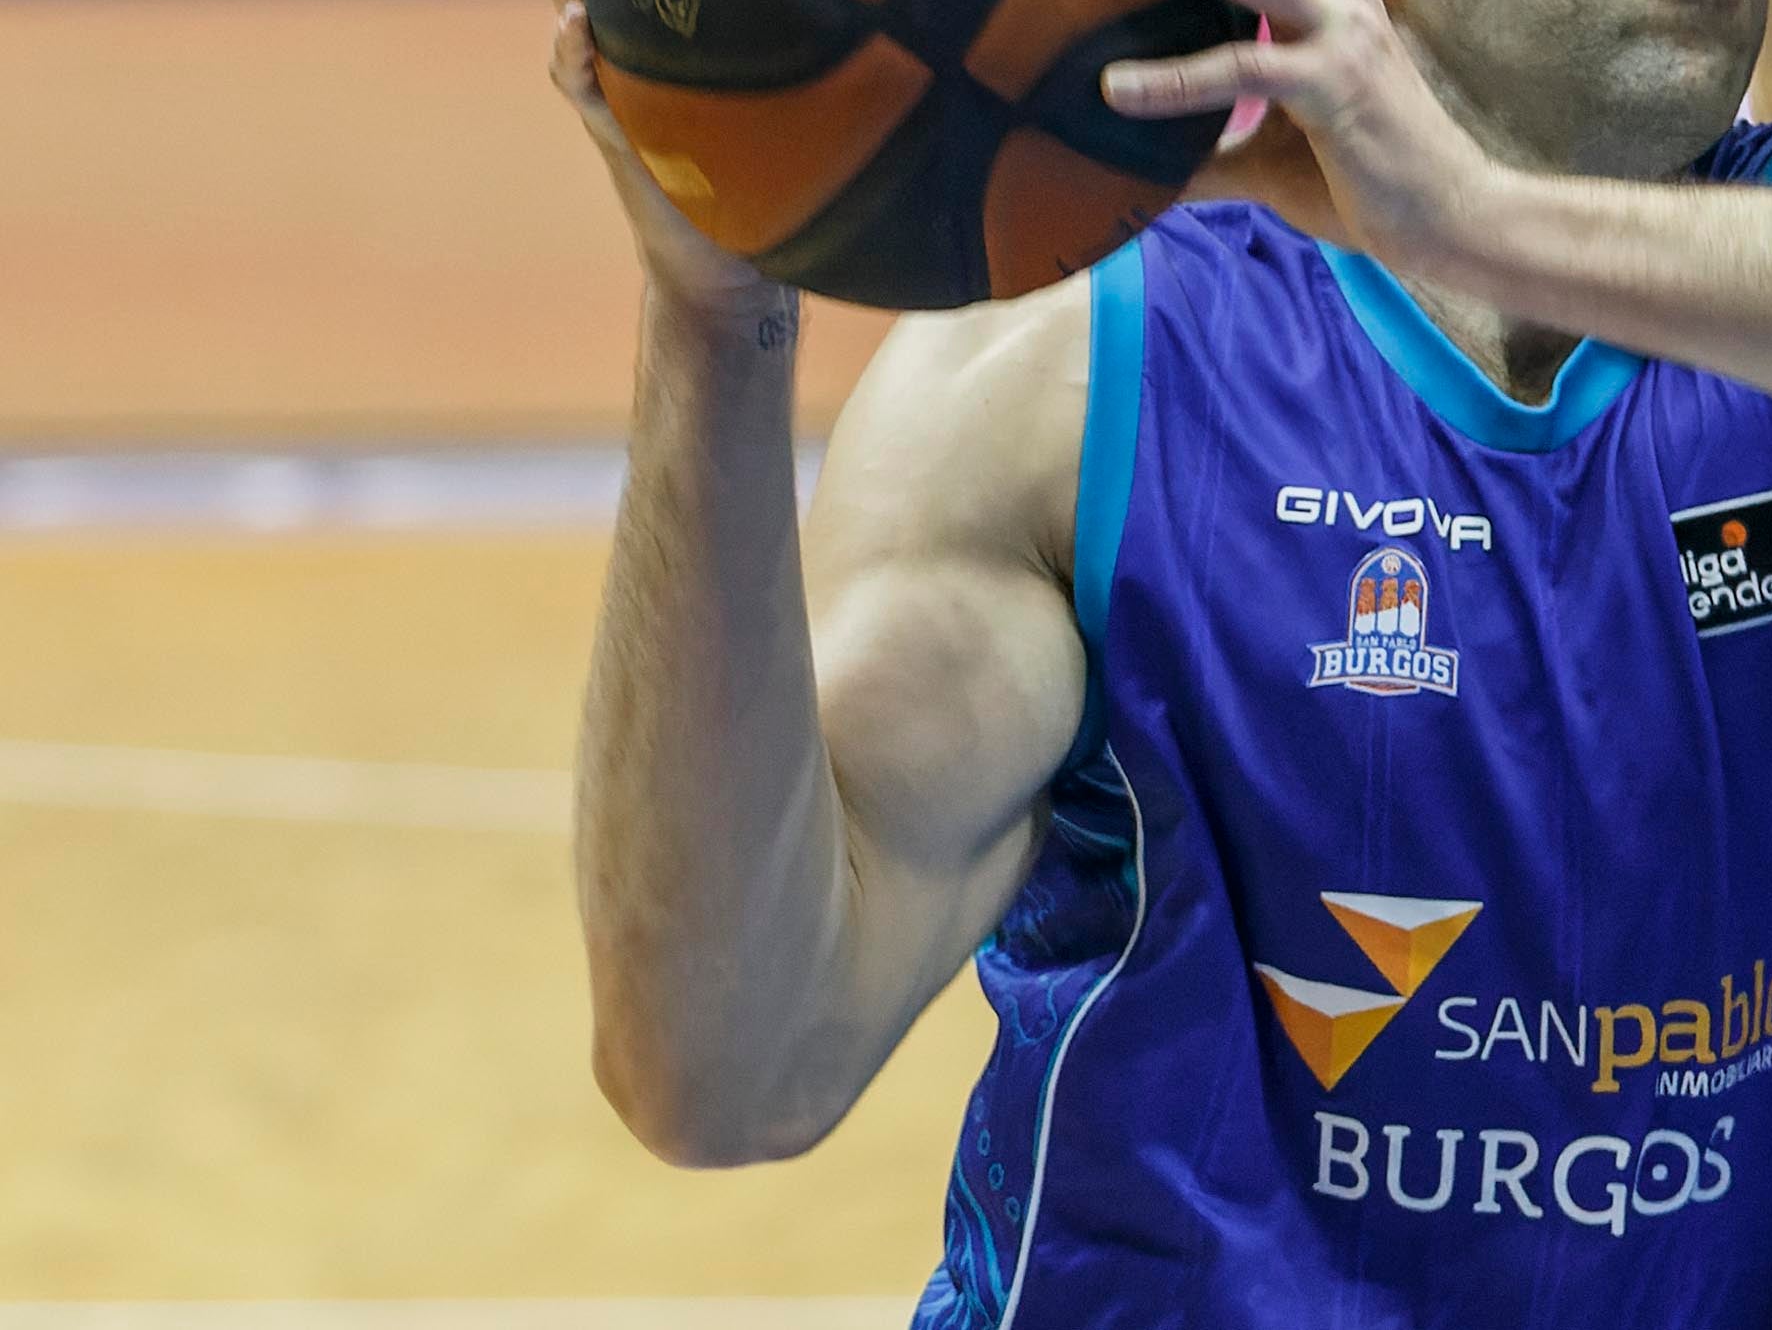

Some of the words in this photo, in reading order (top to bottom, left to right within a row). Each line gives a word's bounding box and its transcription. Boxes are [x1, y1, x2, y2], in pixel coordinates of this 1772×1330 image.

[1276, 485, 1492, 551] GIVOVA
[1679, 547, 1748, 587] liga
[1322, 647, 1451, 684] BURGOS
[1312, 1109, 1734, 1237] BURGOS
